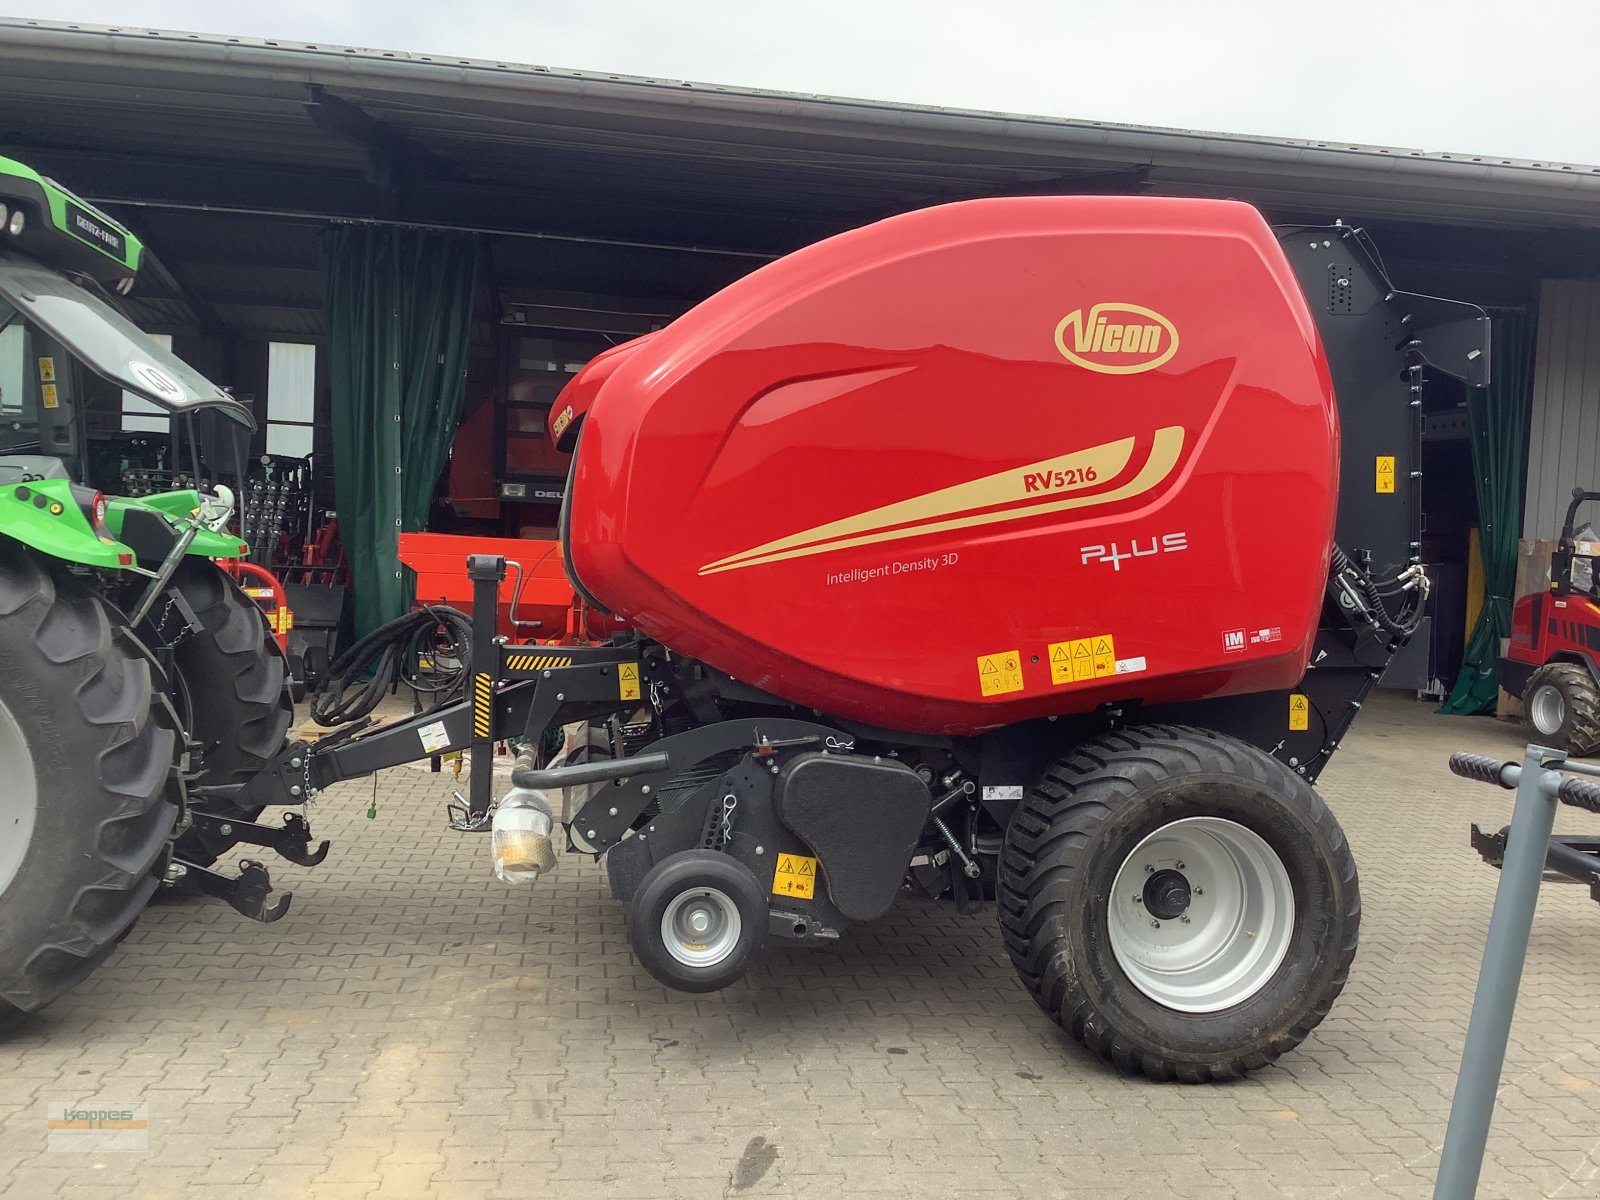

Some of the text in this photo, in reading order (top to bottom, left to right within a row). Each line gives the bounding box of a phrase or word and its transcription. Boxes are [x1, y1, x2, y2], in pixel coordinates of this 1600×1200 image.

[1073, 307, 1162, 354] Vicon
[1023, 466, 1098, 493] RV5216
[826, 552, 959, 585] Intelligent Density 3D
